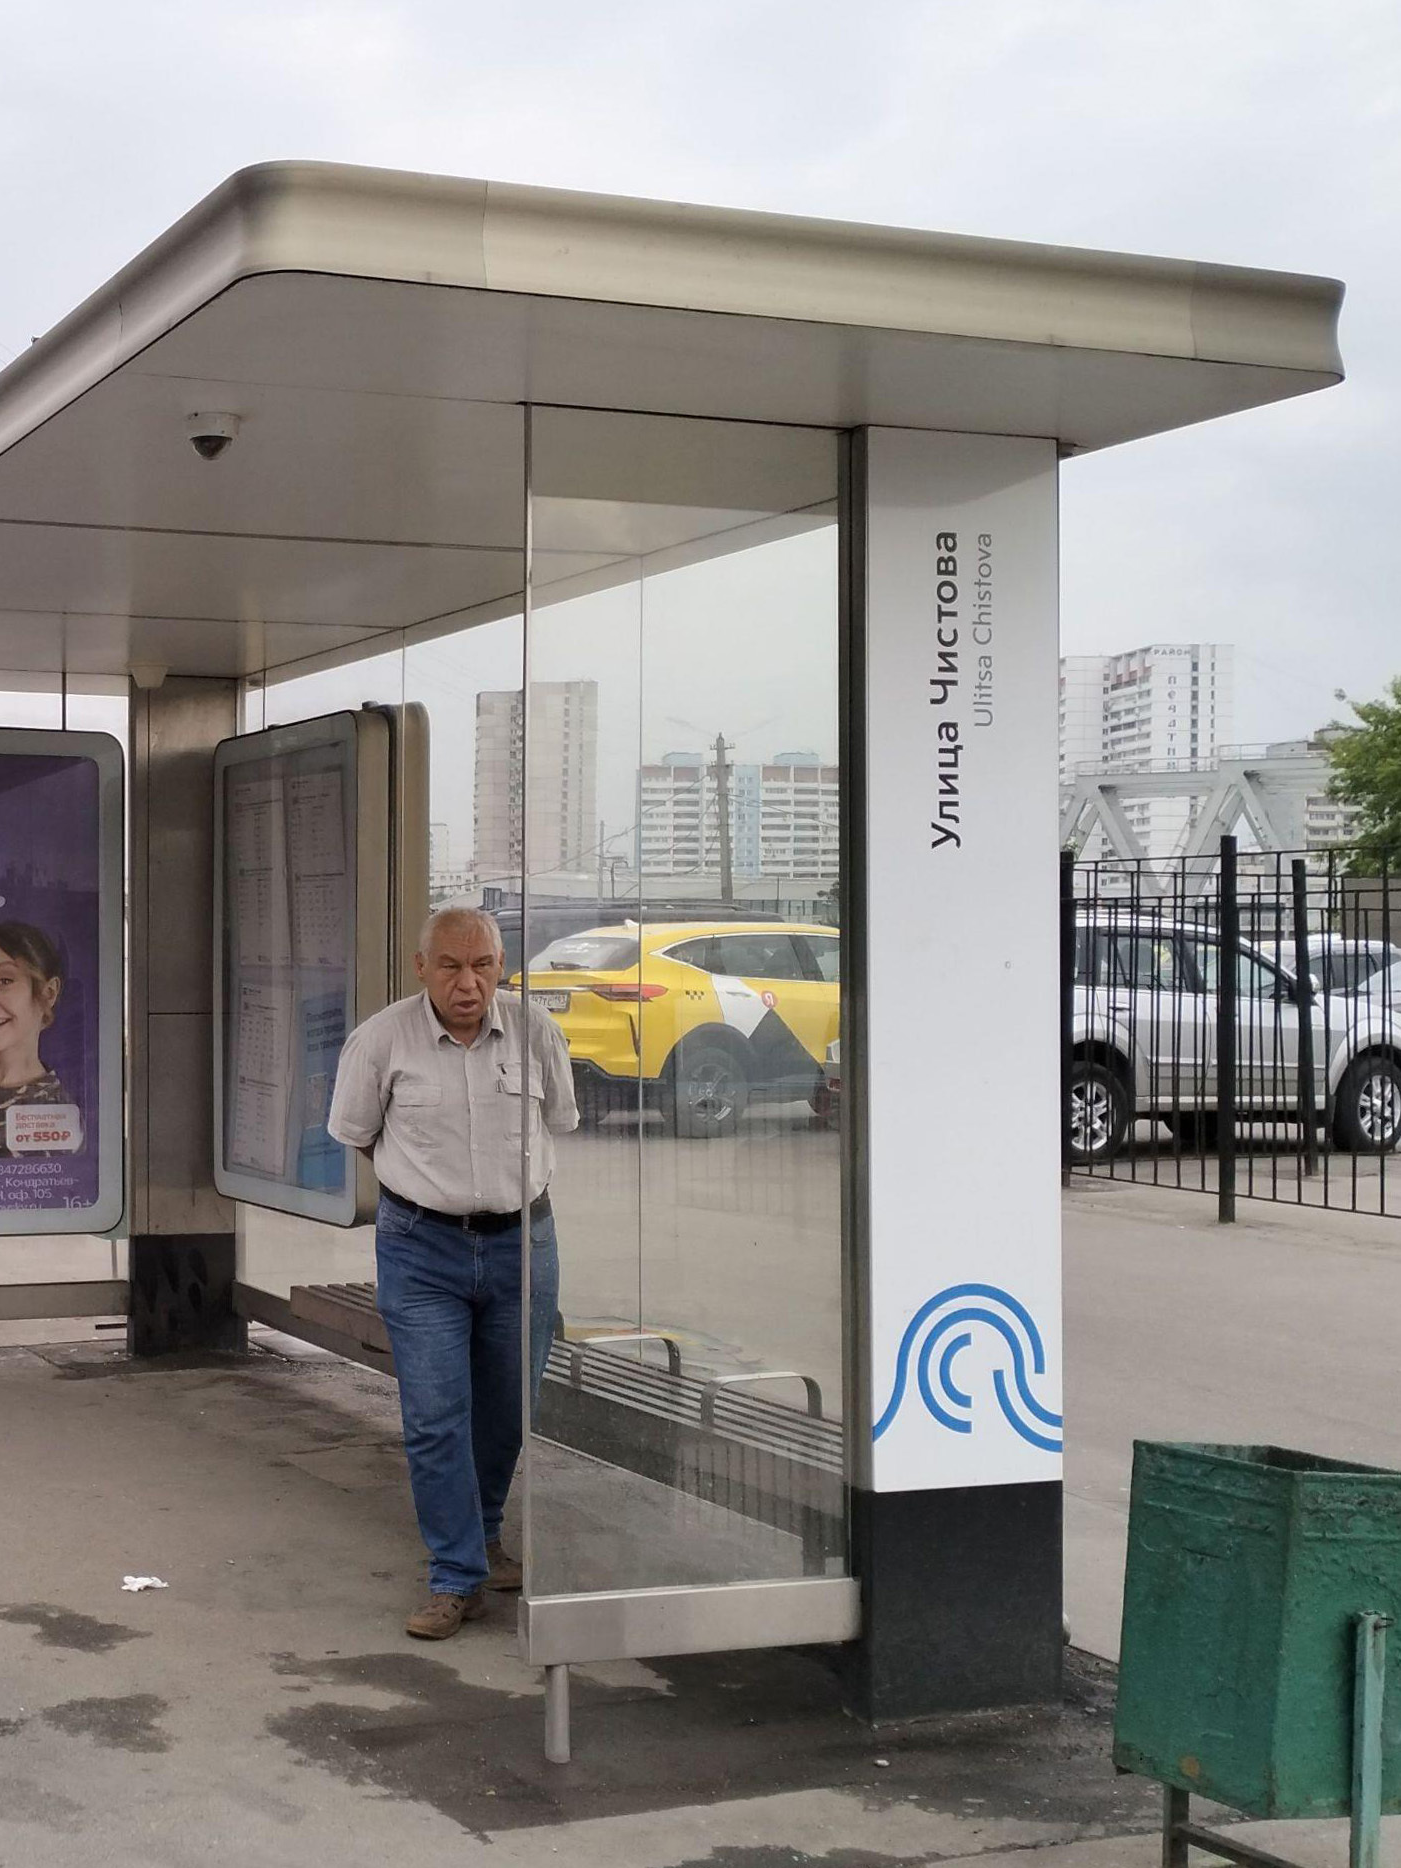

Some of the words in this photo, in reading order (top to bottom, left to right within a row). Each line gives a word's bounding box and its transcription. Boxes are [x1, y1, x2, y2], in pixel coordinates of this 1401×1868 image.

[929, 531, 959, 705] Чистова
[972, 532, 993, 646] Chistova
[973, 654, 994, 728] Ulitsa
[930, 720, 964, 850] Улица
[15, 1133, 31, 1143] от
[33, 1130, 71, 1143] 550₽
